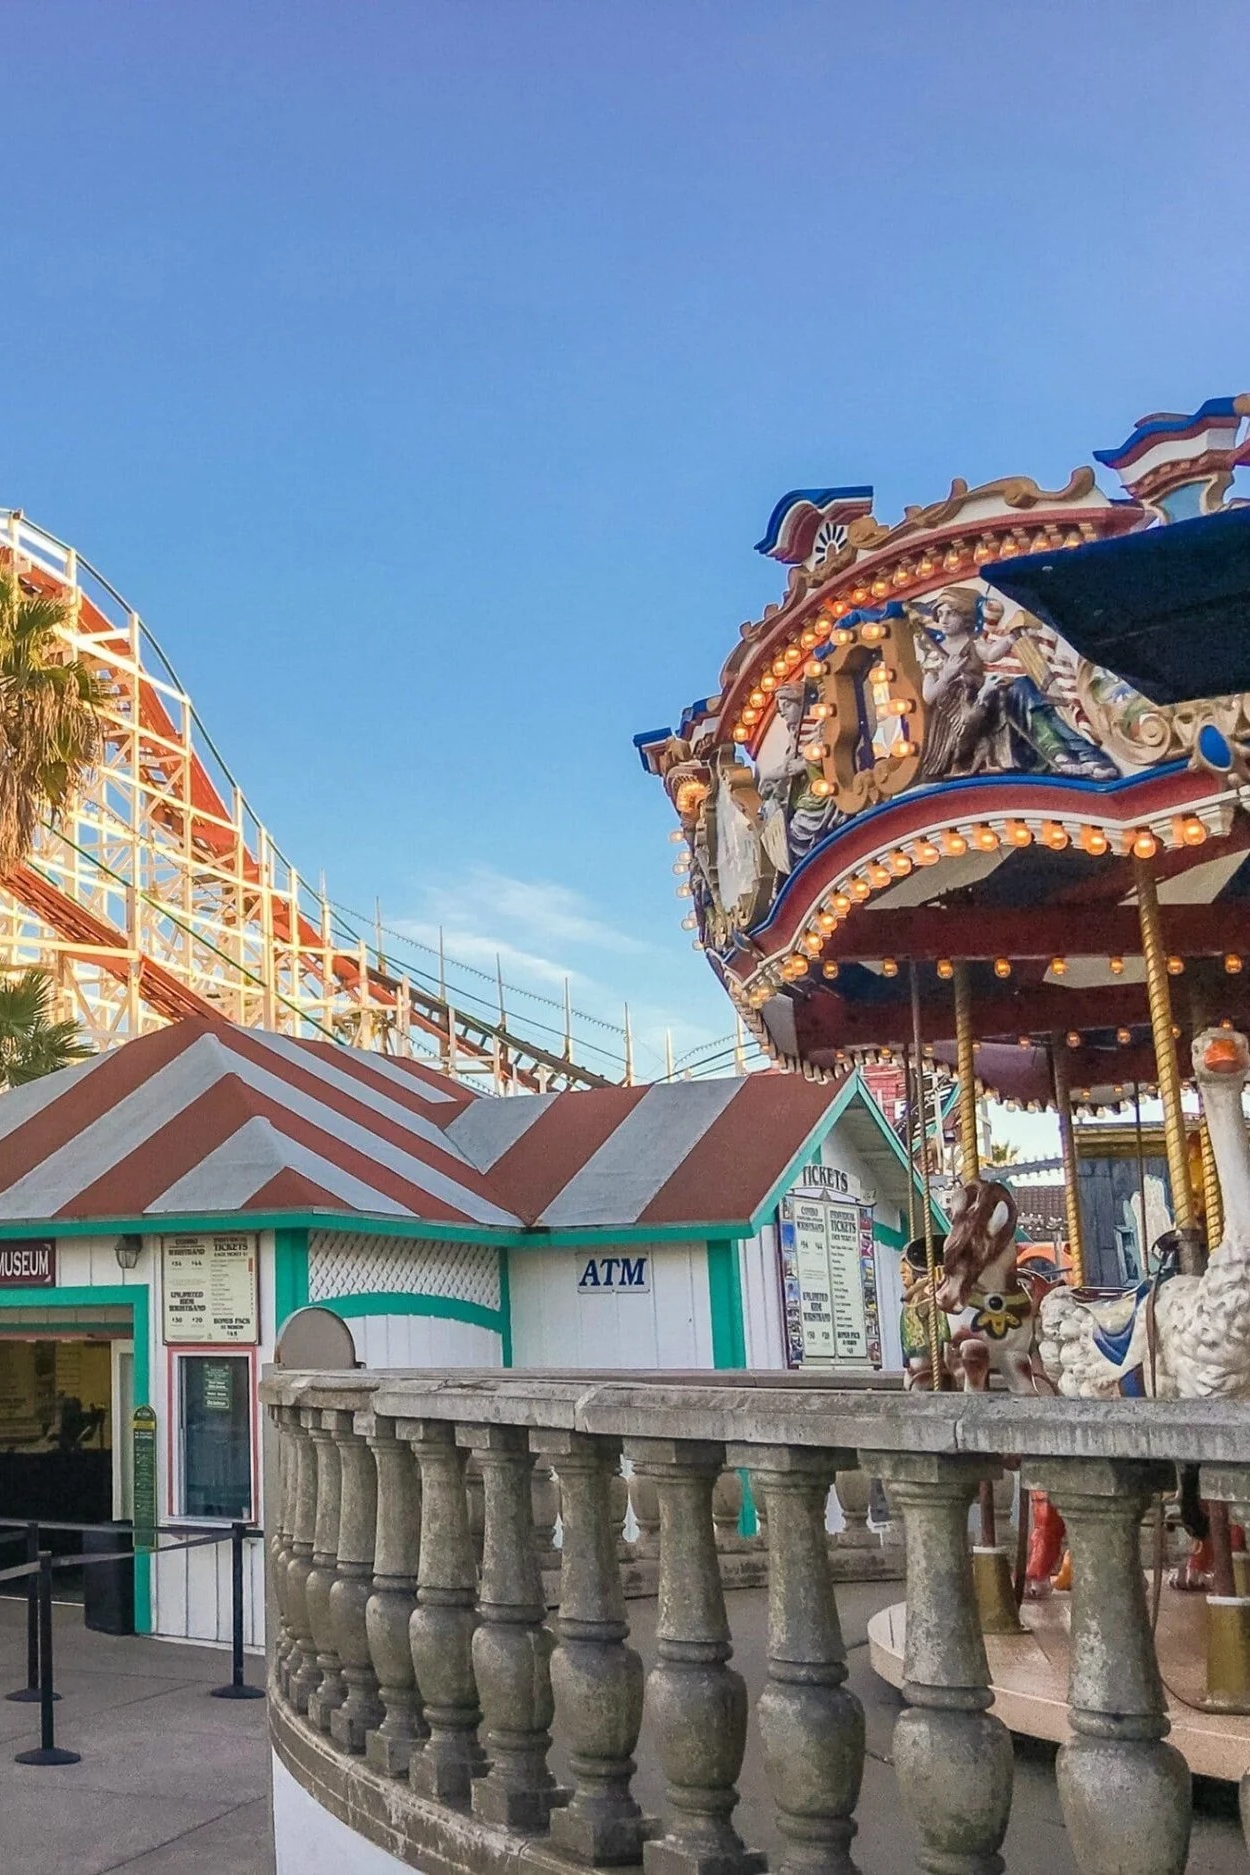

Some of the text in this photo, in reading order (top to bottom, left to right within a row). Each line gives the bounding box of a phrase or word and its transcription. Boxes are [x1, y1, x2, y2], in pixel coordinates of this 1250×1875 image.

[803, 1165, 848, 1194] TICKETS
[830, 1220, 857, 1233] TICKETS
[578, 1257, 647, 1287] ATM
